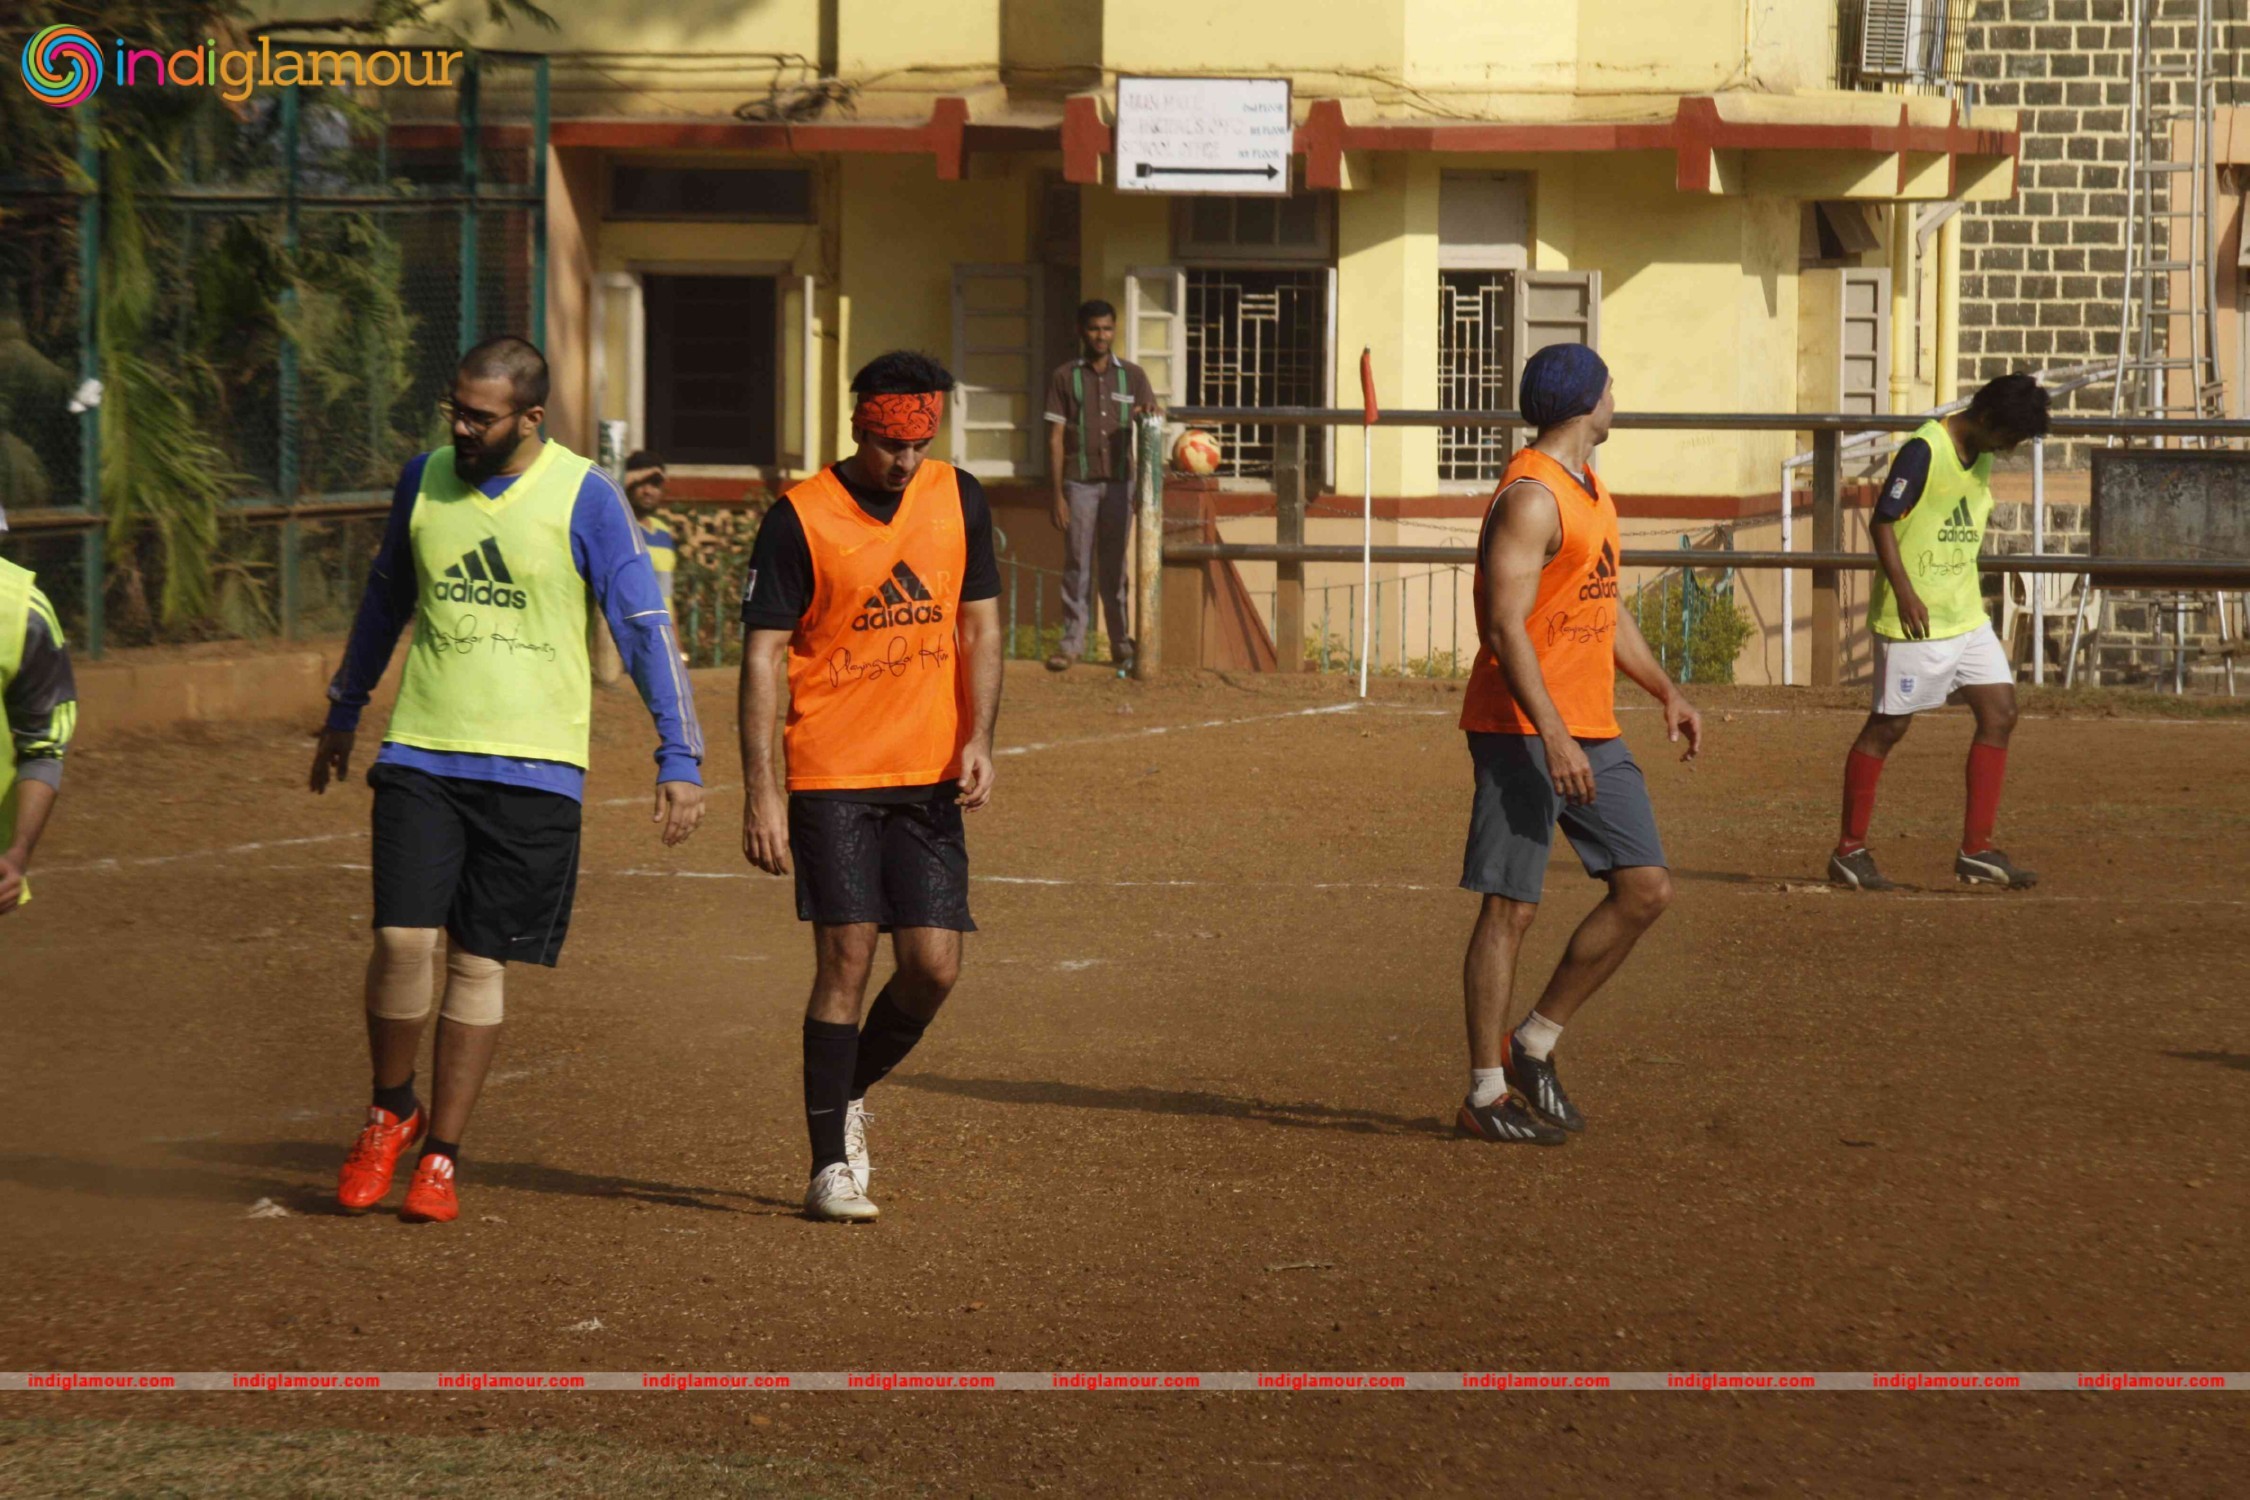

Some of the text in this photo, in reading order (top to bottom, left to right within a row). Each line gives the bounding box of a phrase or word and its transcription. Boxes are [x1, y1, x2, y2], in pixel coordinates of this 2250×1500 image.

[1937, 525, 1980, 543] adidas
[434, 577, 527, 610] adidas
[851, 601, 943, 632] adidas
